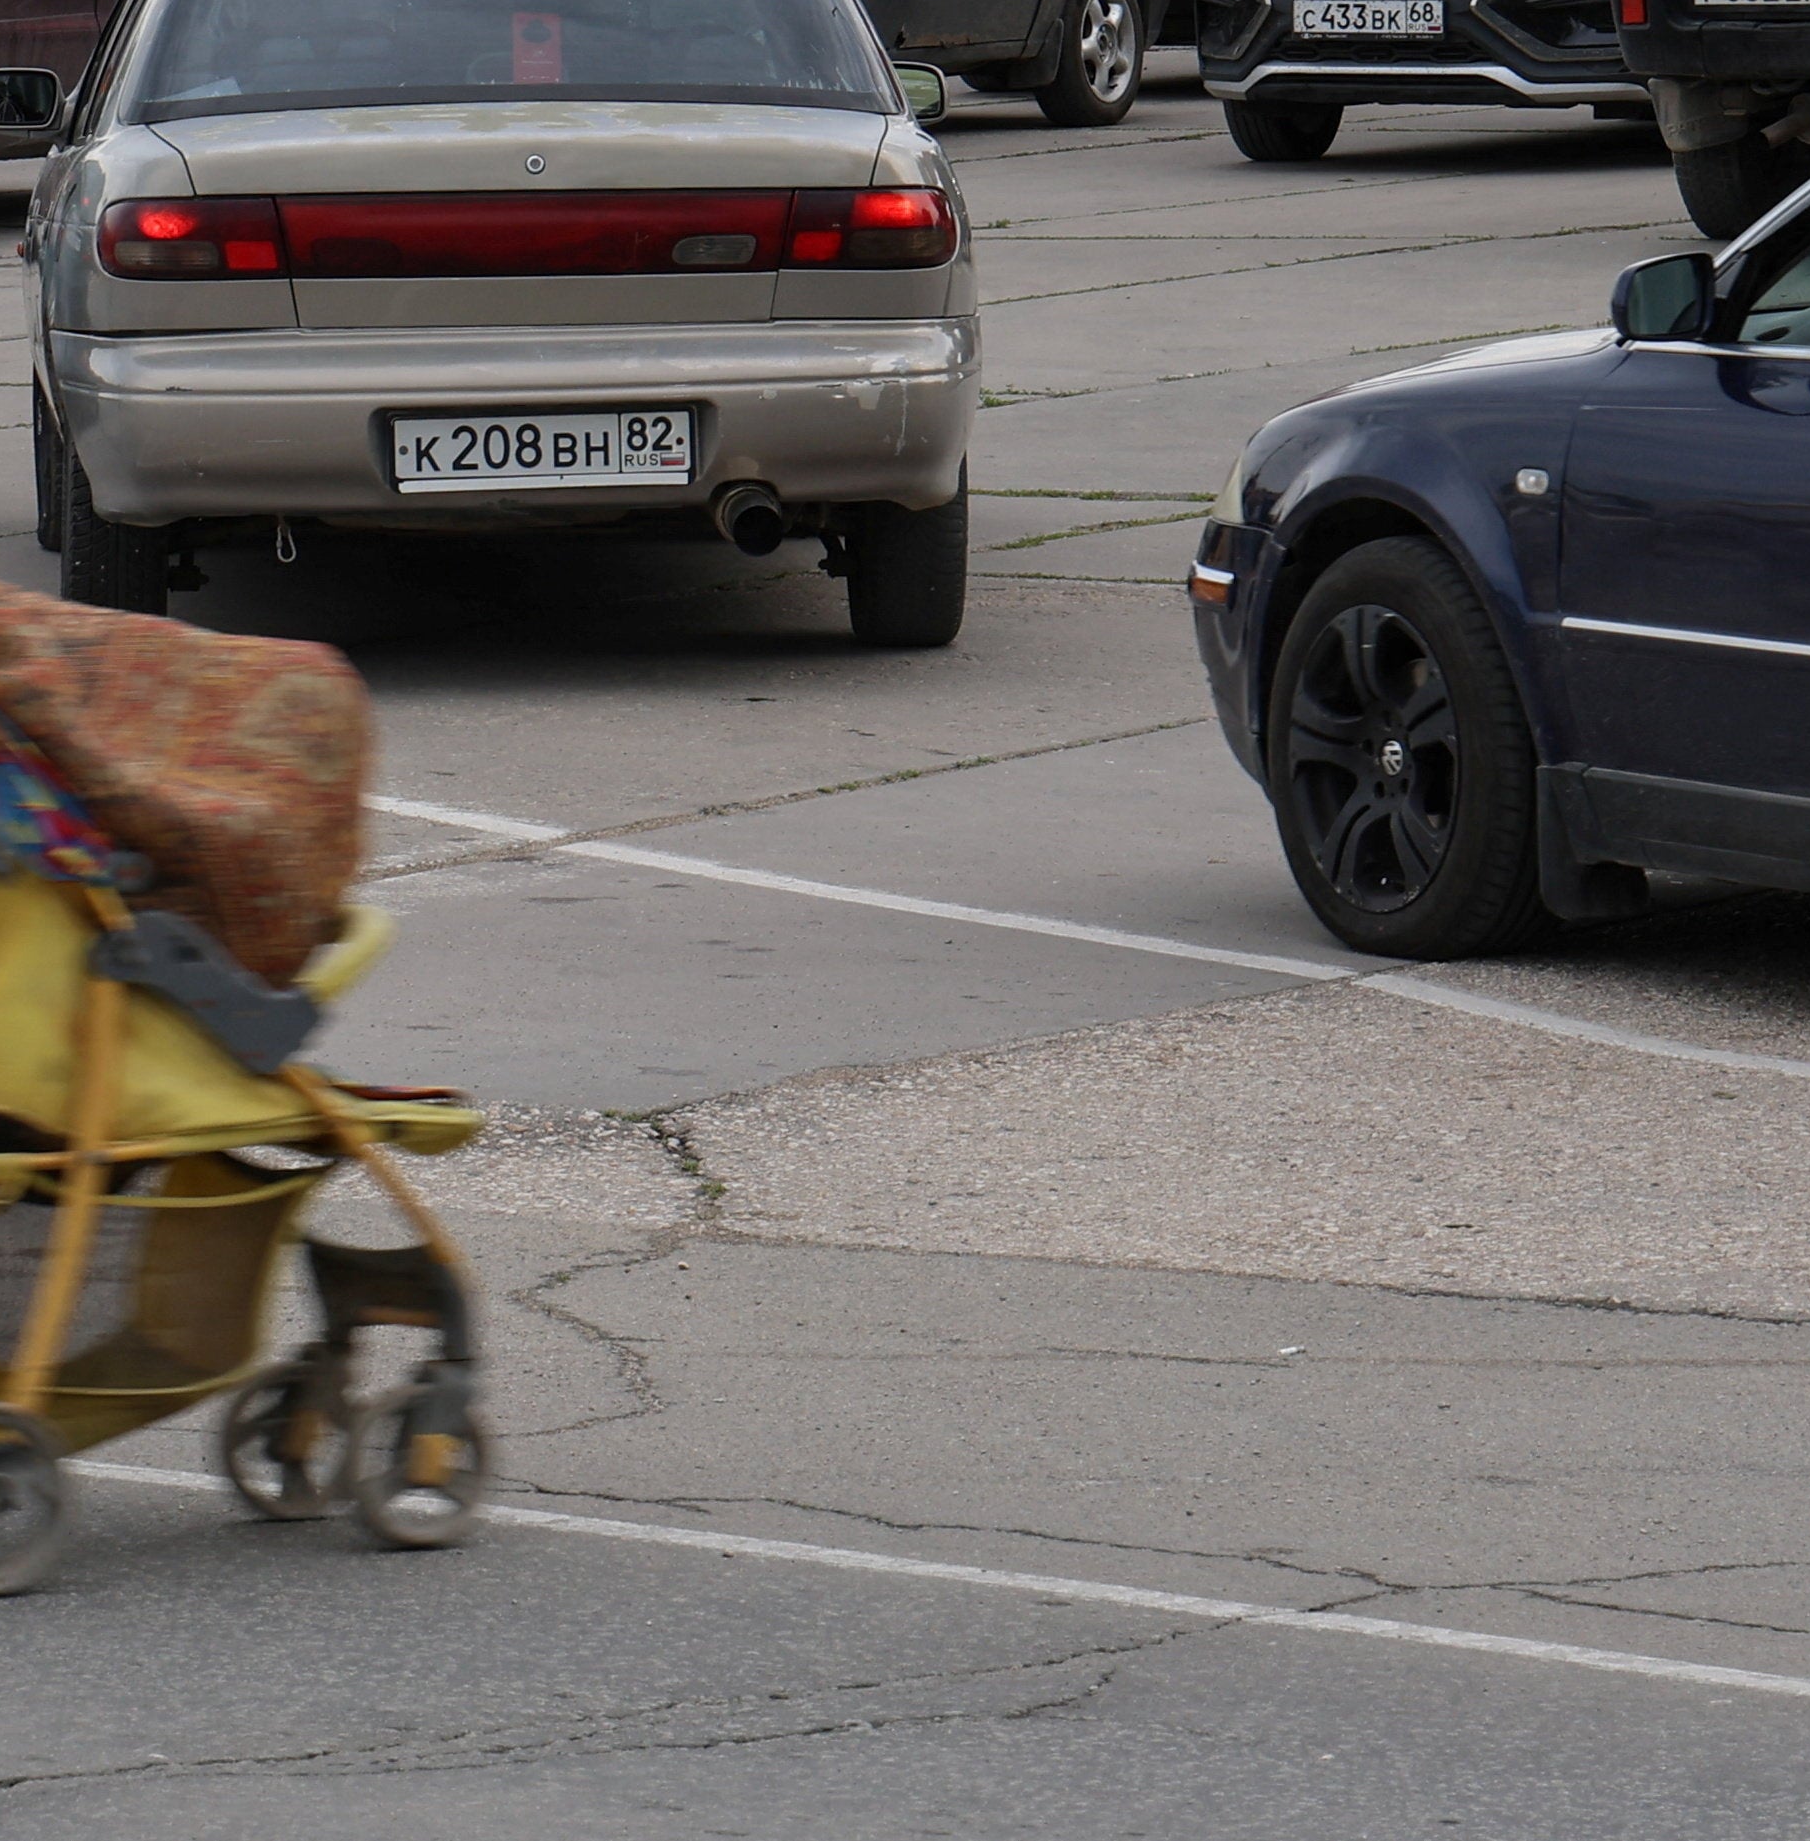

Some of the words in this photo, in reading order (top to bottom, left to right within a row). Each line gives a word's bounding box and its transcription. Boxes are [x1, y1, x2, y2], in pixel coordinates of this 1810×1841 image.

[1409, 2, 1434, 22] 68
[627, 416, 673, 451] 82
[624, 454, 659, 467] RUS
